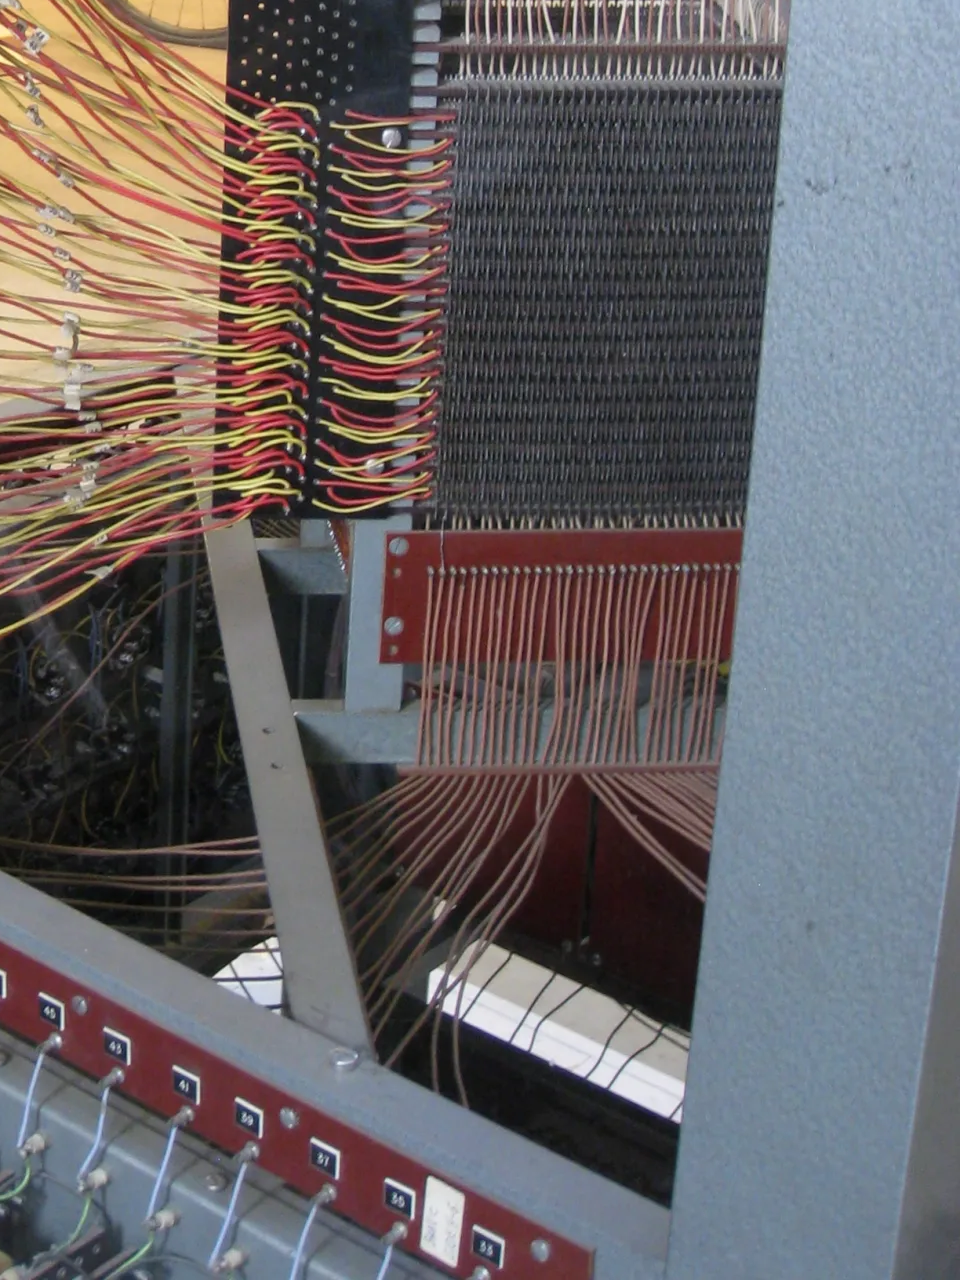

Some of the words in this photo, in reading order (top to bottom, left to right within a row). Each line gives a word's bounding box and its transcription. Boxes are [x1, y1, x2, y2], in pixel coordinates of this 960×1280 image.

[43, 1005, 56, 1020] 45
[109, 1040, 122, 1055] 43
[178, 1079, 189, 1093] 41
[241, 1110, 256, 1126] 39
[317, 1150, 331, 1167] 37
[391, 1191, 406, 1208] 35
